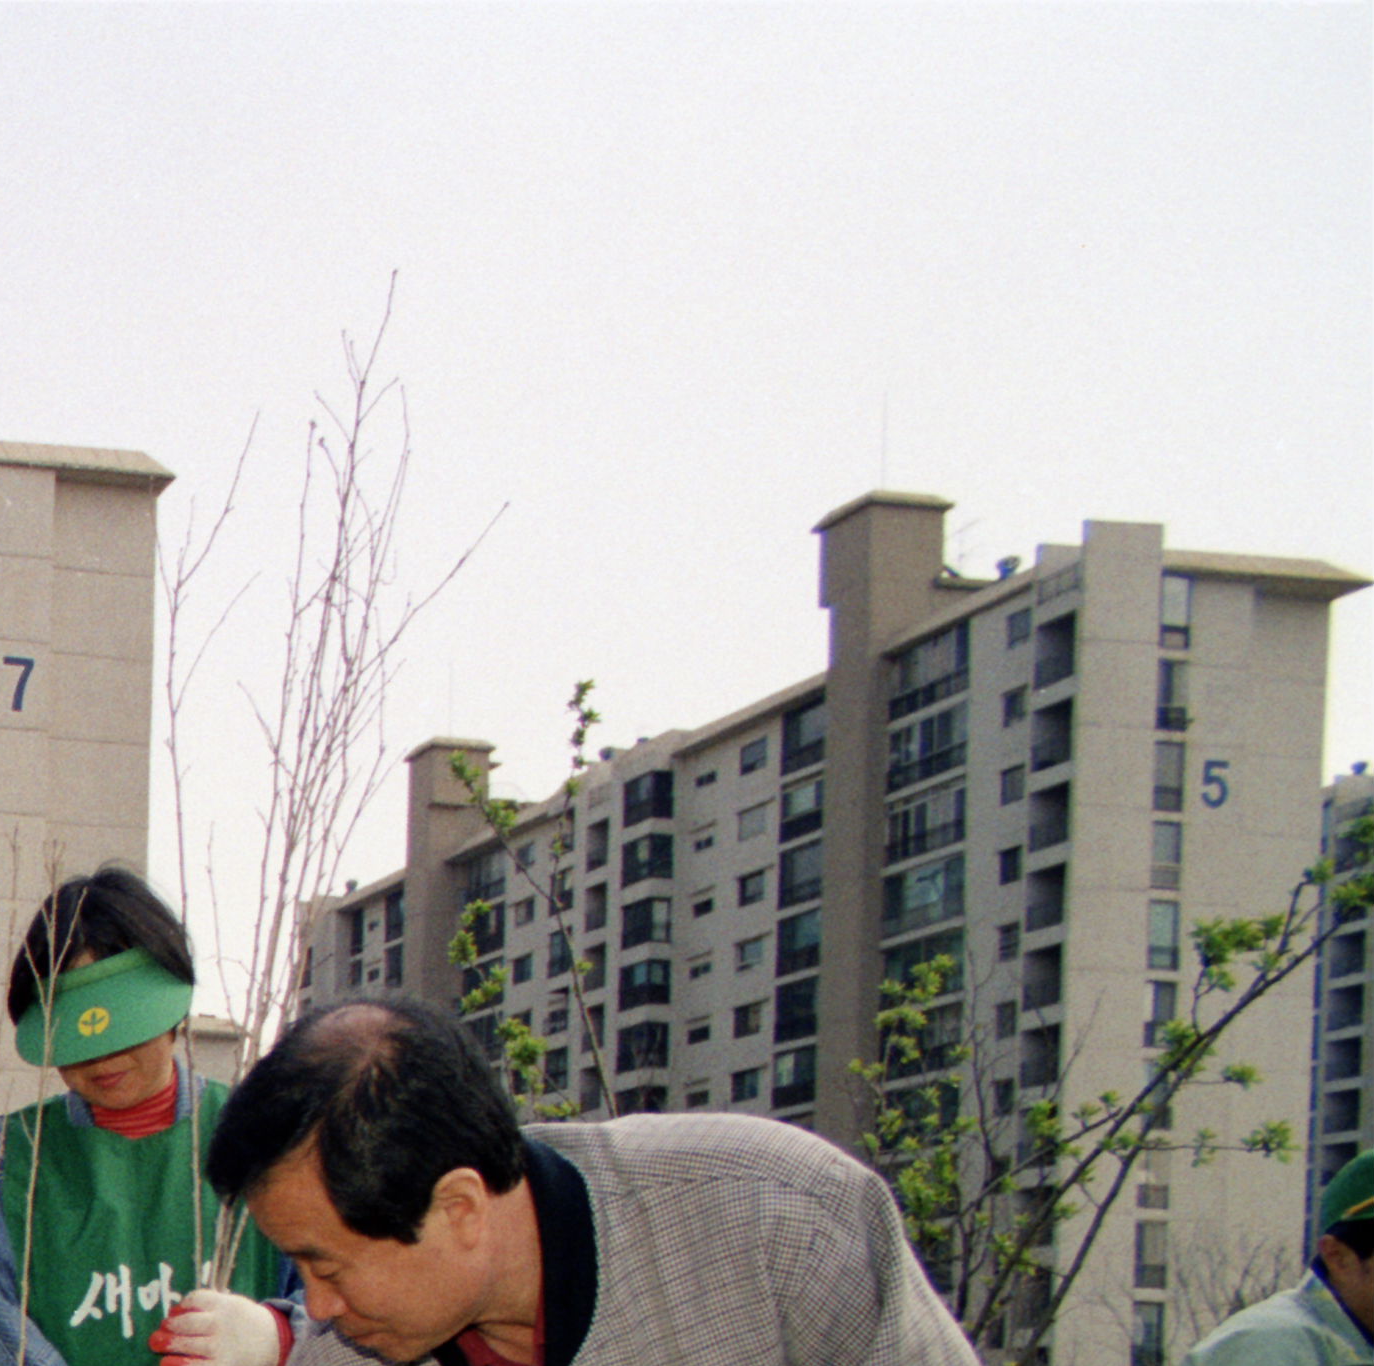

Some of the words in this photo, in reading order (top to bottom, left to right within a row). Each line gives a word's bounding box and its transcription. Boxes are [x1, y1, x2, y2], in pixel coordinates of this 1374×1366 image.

[3, 657, 35, 711] 7
[1201, 760, 1229, 809] 5
[69, 1261, 212, 1339] 새마
